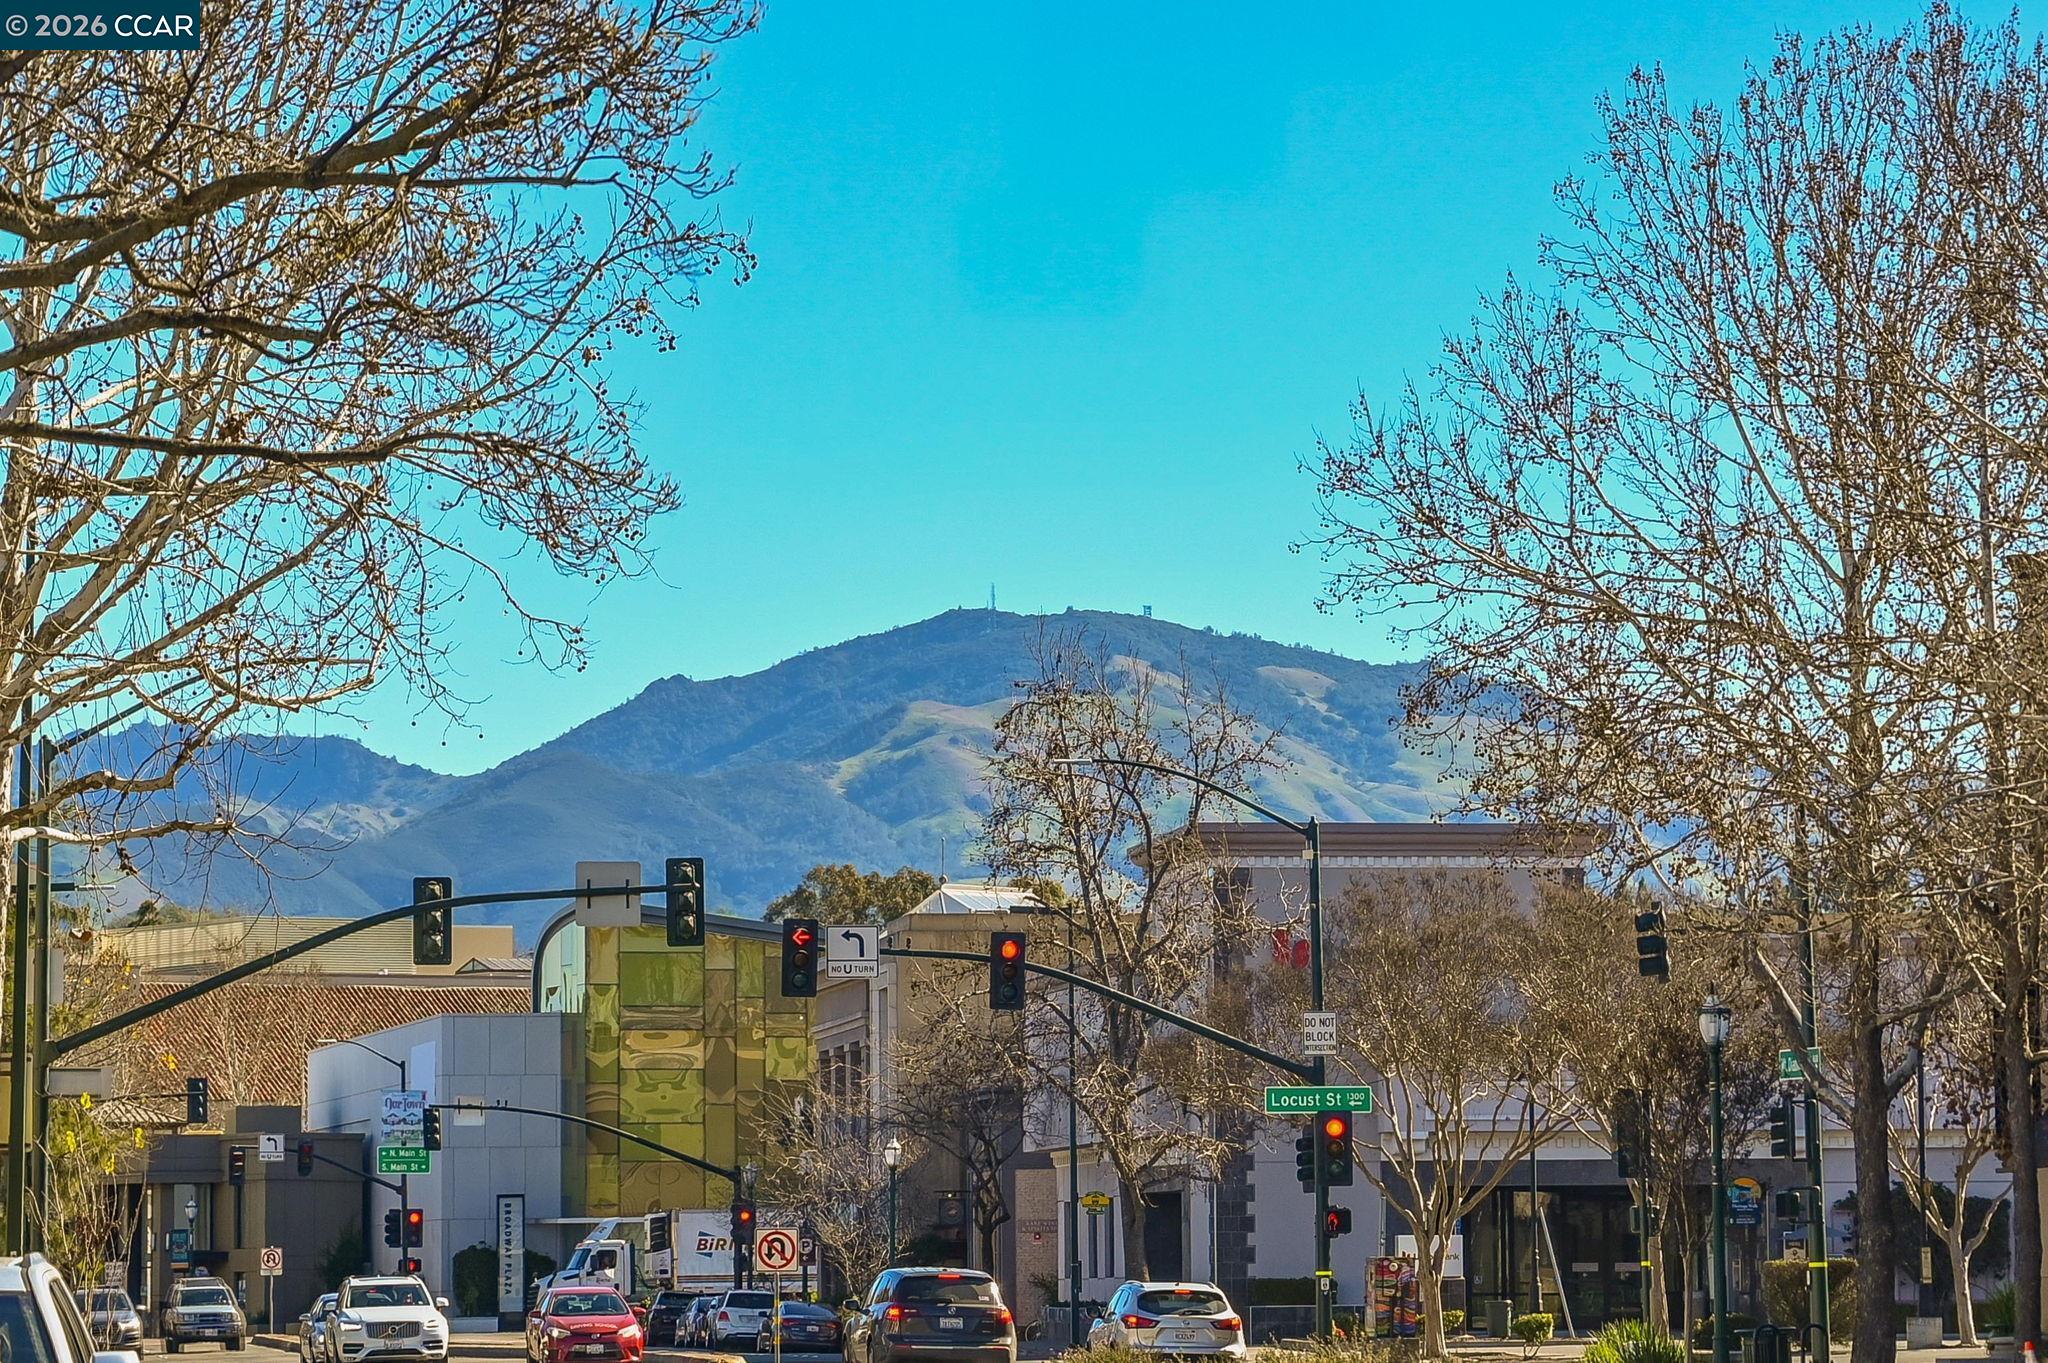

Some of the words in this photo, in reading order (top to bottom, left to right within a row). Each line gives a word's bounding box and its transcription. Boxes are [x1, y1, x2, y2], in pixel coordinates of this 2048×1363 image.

[831, 965, 842, 973] NO
[843, 964, 852, 974] U
[854, 965, 875, 973] TURN
[1304, 1017, 1316, 1028] DO
[1319, 1017, 1335, 1028] NOT
[1305, 1031, 1335, 1042] BLOCK
[1271, 1093, 1320, 1107] Locust
[1326, 1092, 1342, 1106] St
[389, 1149, 397, 1157] N.
[399, 1149, 416, 1157] Main
[418, 1149, 427, 1157] St
[381, 1163, 389, 1171] S.
[391, 1163, 407, 1171] Main
[410, 1163, 418, 1171] St
[504, 1202, 512, 1259] BROADWAY
[504, 1263, 513, 1295] PLAZA
